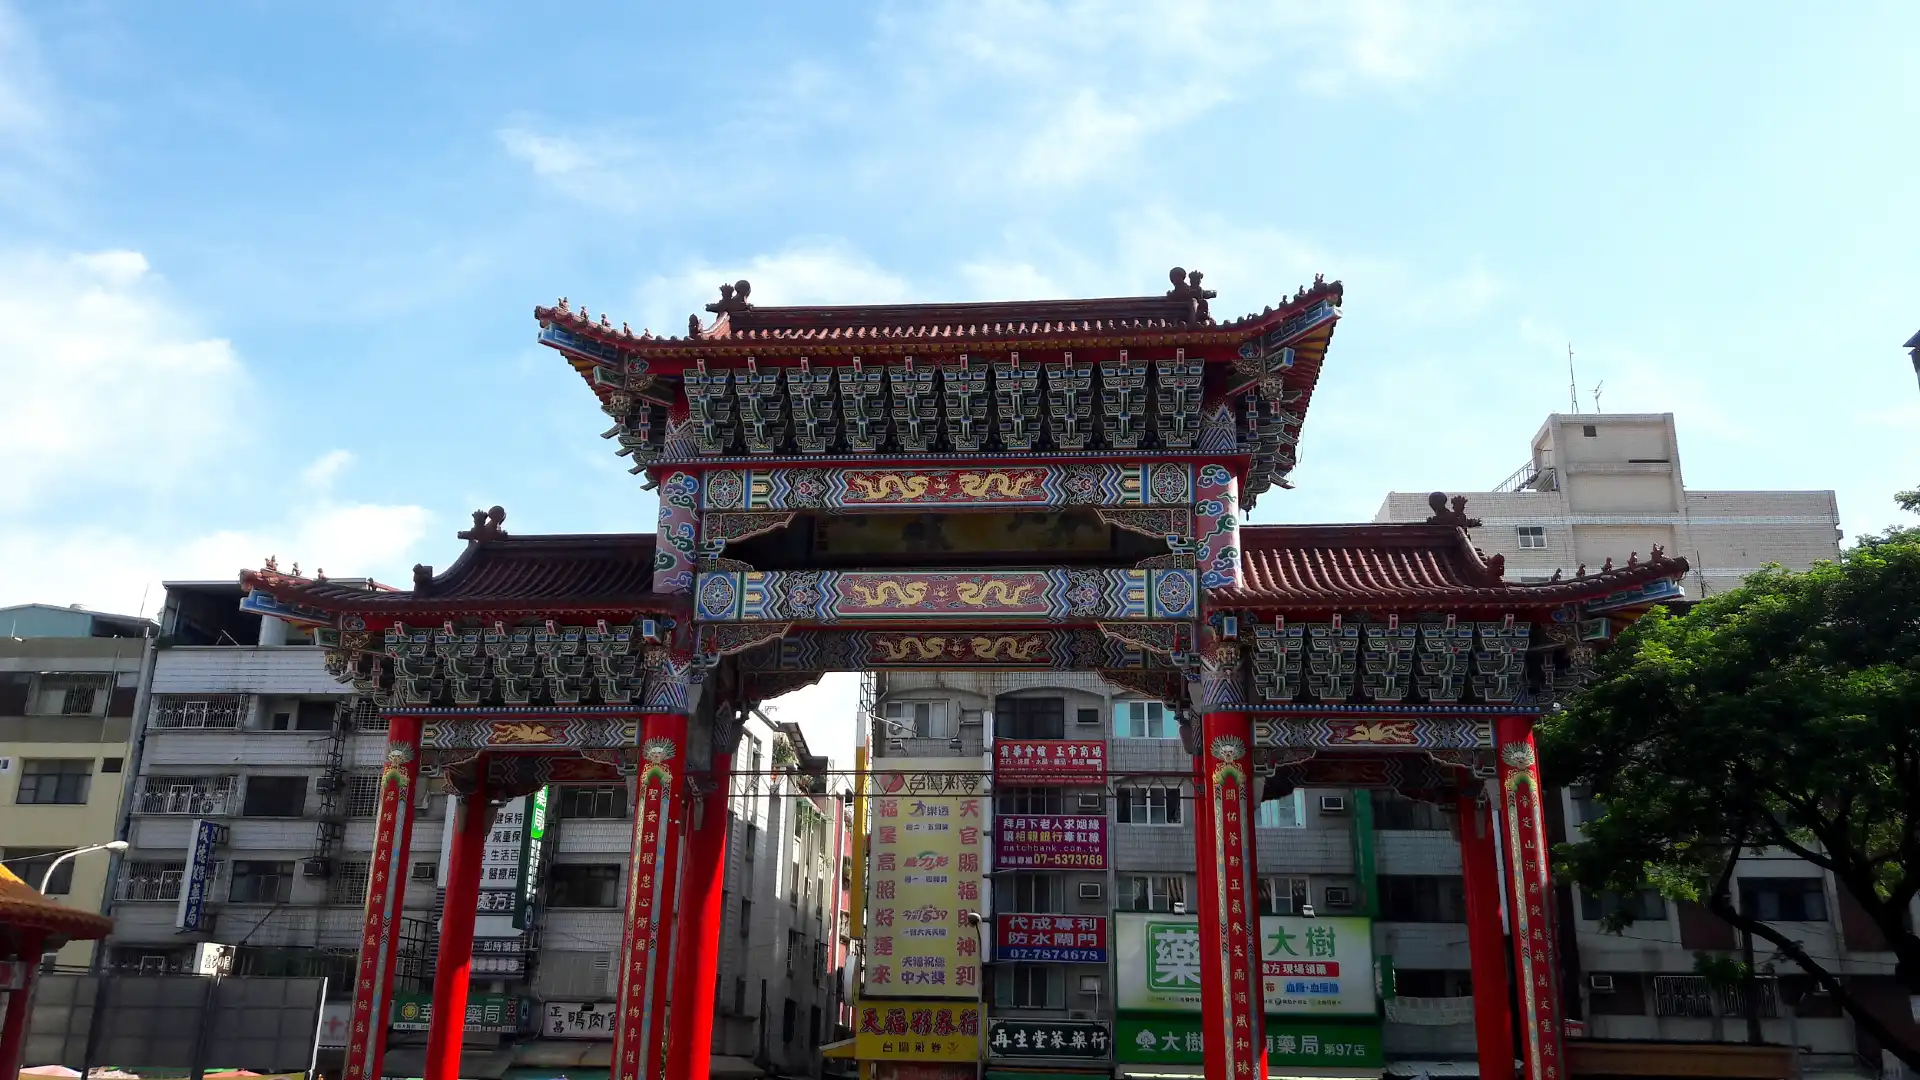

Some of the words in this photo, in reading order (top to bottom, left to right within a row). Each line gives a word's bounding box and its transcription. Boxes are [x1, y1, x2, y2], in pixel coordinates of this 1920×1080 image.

[1008, 931, 1097, 947] 防水閘門
[1267, 925, 1336, 957] 大樹
[1010, 948, 1098, 961] 07-7874678
[901, 970, 946, 985] 中大獎
